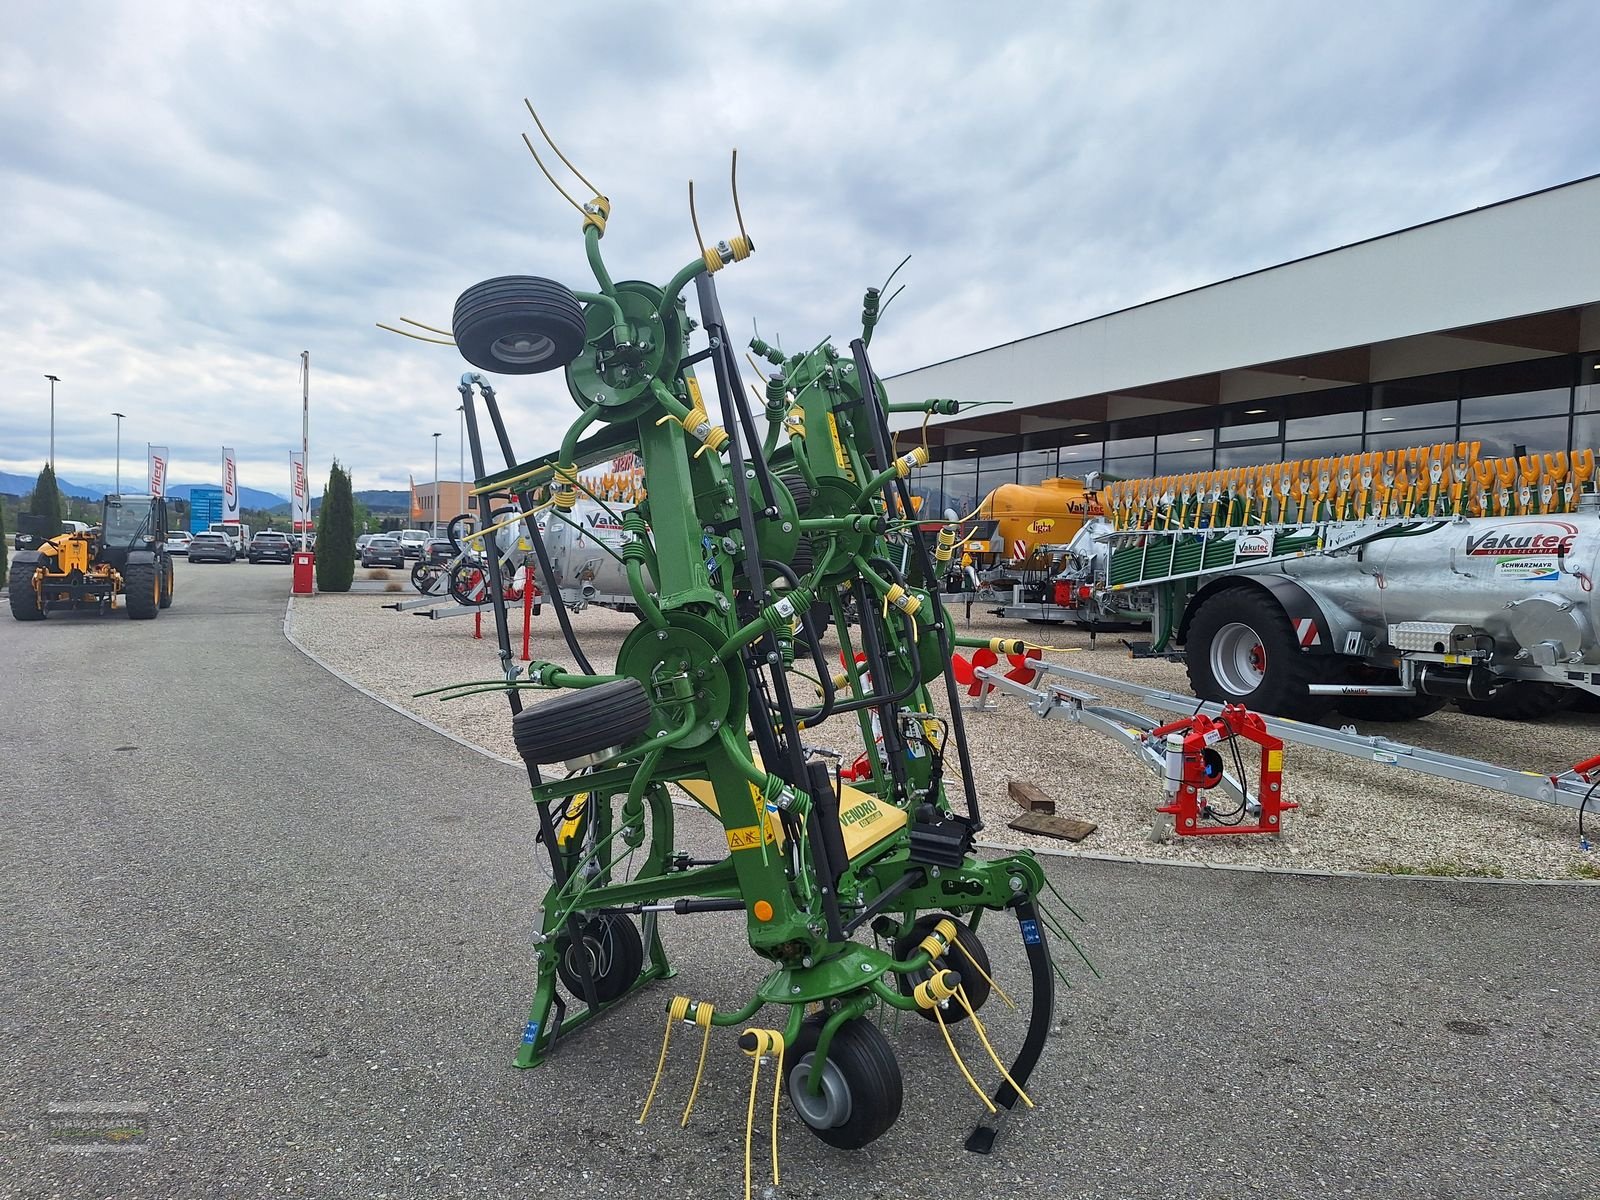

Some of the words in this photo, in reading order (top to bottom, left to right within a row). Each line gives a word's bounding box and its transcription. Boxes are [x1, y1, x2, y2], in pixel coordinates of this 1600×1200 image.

[151, 456, 164, 496] Fliegl
[225, 457, 234, 496] Fliegl
[294, 461, 304, 498] Fliegl
[1033, 521, 1051, 534] light
[1238, 542, 1269, 554] Vakutec
[1465, 530, 1577, 556] Vakutec
[839, 799, 878, 827] VENDRO
